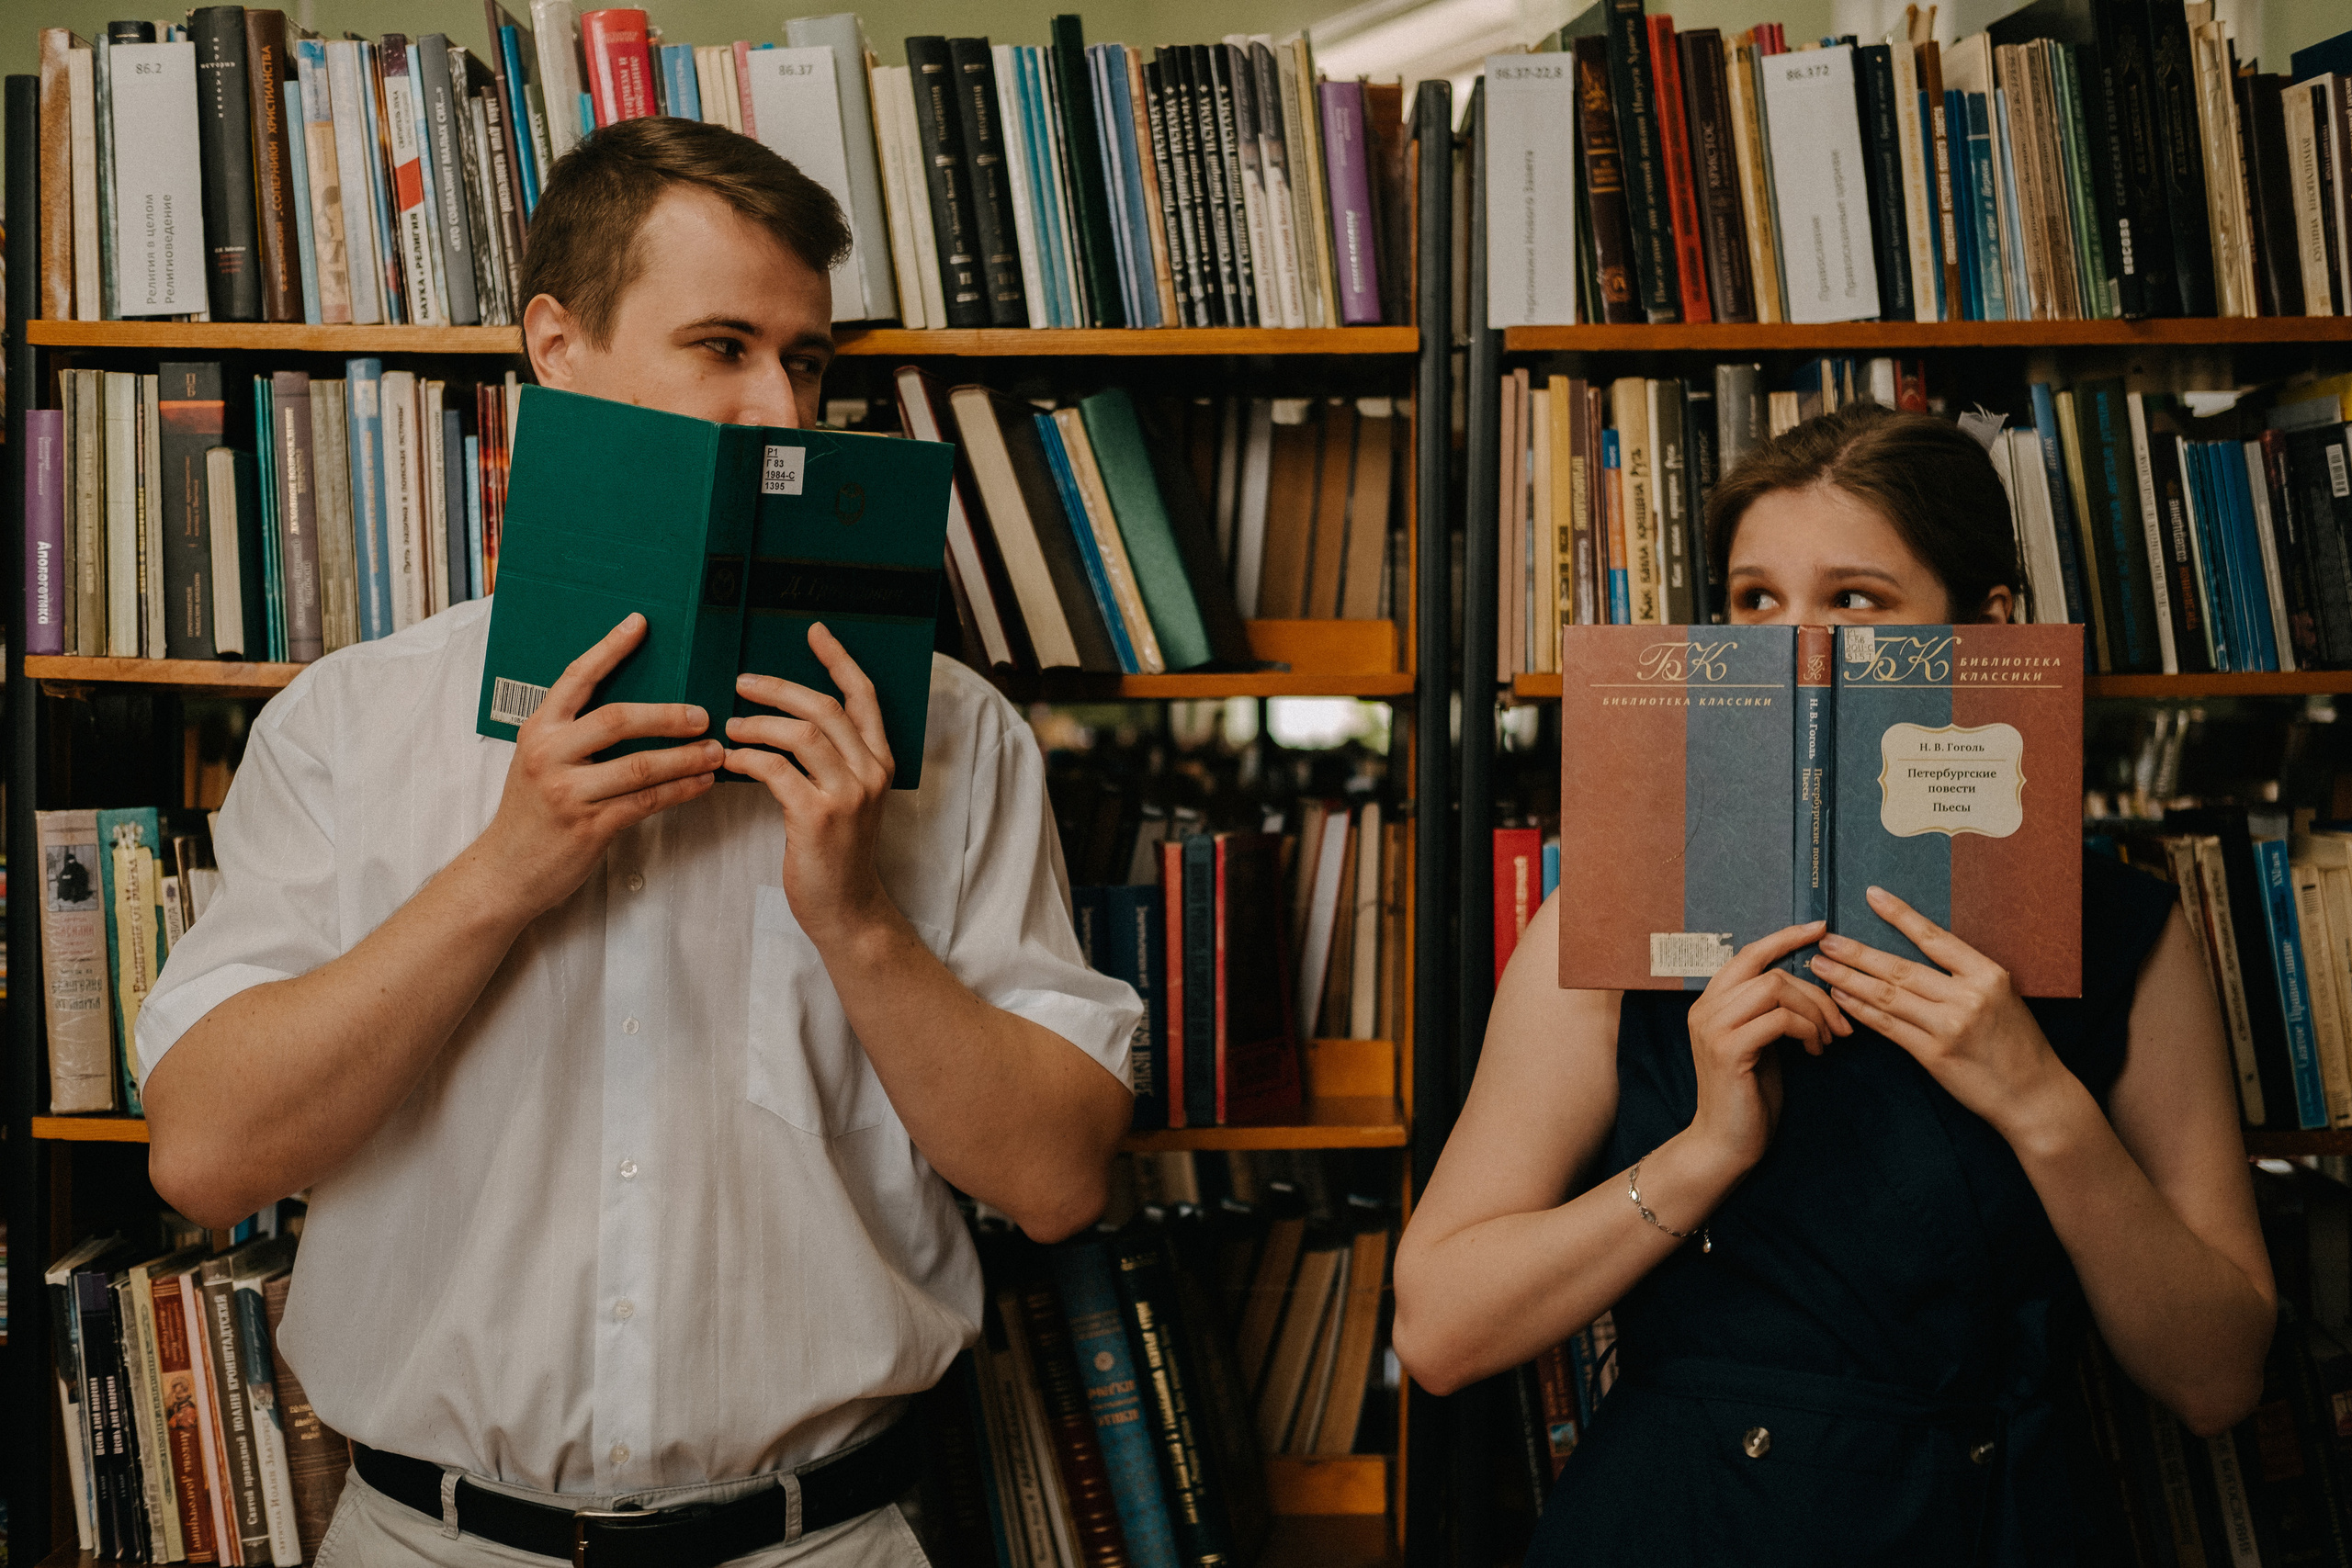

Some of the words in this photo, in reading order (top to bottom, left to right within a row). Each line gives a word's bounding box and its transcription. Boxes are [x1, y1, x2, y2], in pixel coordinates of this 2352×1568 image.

[135, 63, 162, 73] 86.2
[778, 64, 813, 76] 86.37
[1786, 64, 1828, 82] 86.372
[261, 44, 277, 133] ХРИСТИАНСТВА
[1149, 106, 1168, 159] ПАЛАМА
[1164, 99, 1182, 153] ПАЛАМА
[1178, 96, 1195, 151] ПАЛАМА
[1198, 97, 1217, 152] ПАЛАМА
[1218, 96, 1237, 152] ПАЛАМА
[268, 141, 283, 211] СОПЕРНИКИ
[410, 212, 424, 268] РЕЛИГИЯ
[2119, 219, 2134, 275] КОСОВО
[418, 279, 429, 320] НАУКА
[765, 471, 796, 479] 1984-С
[774, 459, 784, 468] 83
[764, 482, 785, 491] 1395
[37, 540, 53, 626] Апологетика
[1960, 657, 2062, 668] БИБЛИОТЕКА
[1960, 671, 2043, 682] КЛАССИКИ
[1602, 697, 1692, 707] БИБЛИОТЕКА
[1699, 697, 1773, 707] КЛАССИКИ
[1810, 698, 1820, 710] Н.
[1810, 712, 1820, 723] В.
[1808, 725, 1820, 760] Гоголь
[1919, 743, 1930, 752] Н.
[1934, 743, 1944, 752] В.
[1947, 742, 1984, 752] Гоголь
[1801, 768, 1813, 801] Пьесы
[1907, 768, 1997, 781] Петербургские
[1928, 784, 1976, 794] повести
[1812, 768, 1825, 843] Петербургские
[1933, 802, 1971, 813] Пьесы
[1812, 847, 1822, 888] повести
[215, 1293, 240, 1391] КРОНШТАДТСКИЙ
[230, 1393, 245, 1431] ИОАНН
[237, 1435, 255, 1487] праведный
[243, 1489, 259, 1526] Святой
